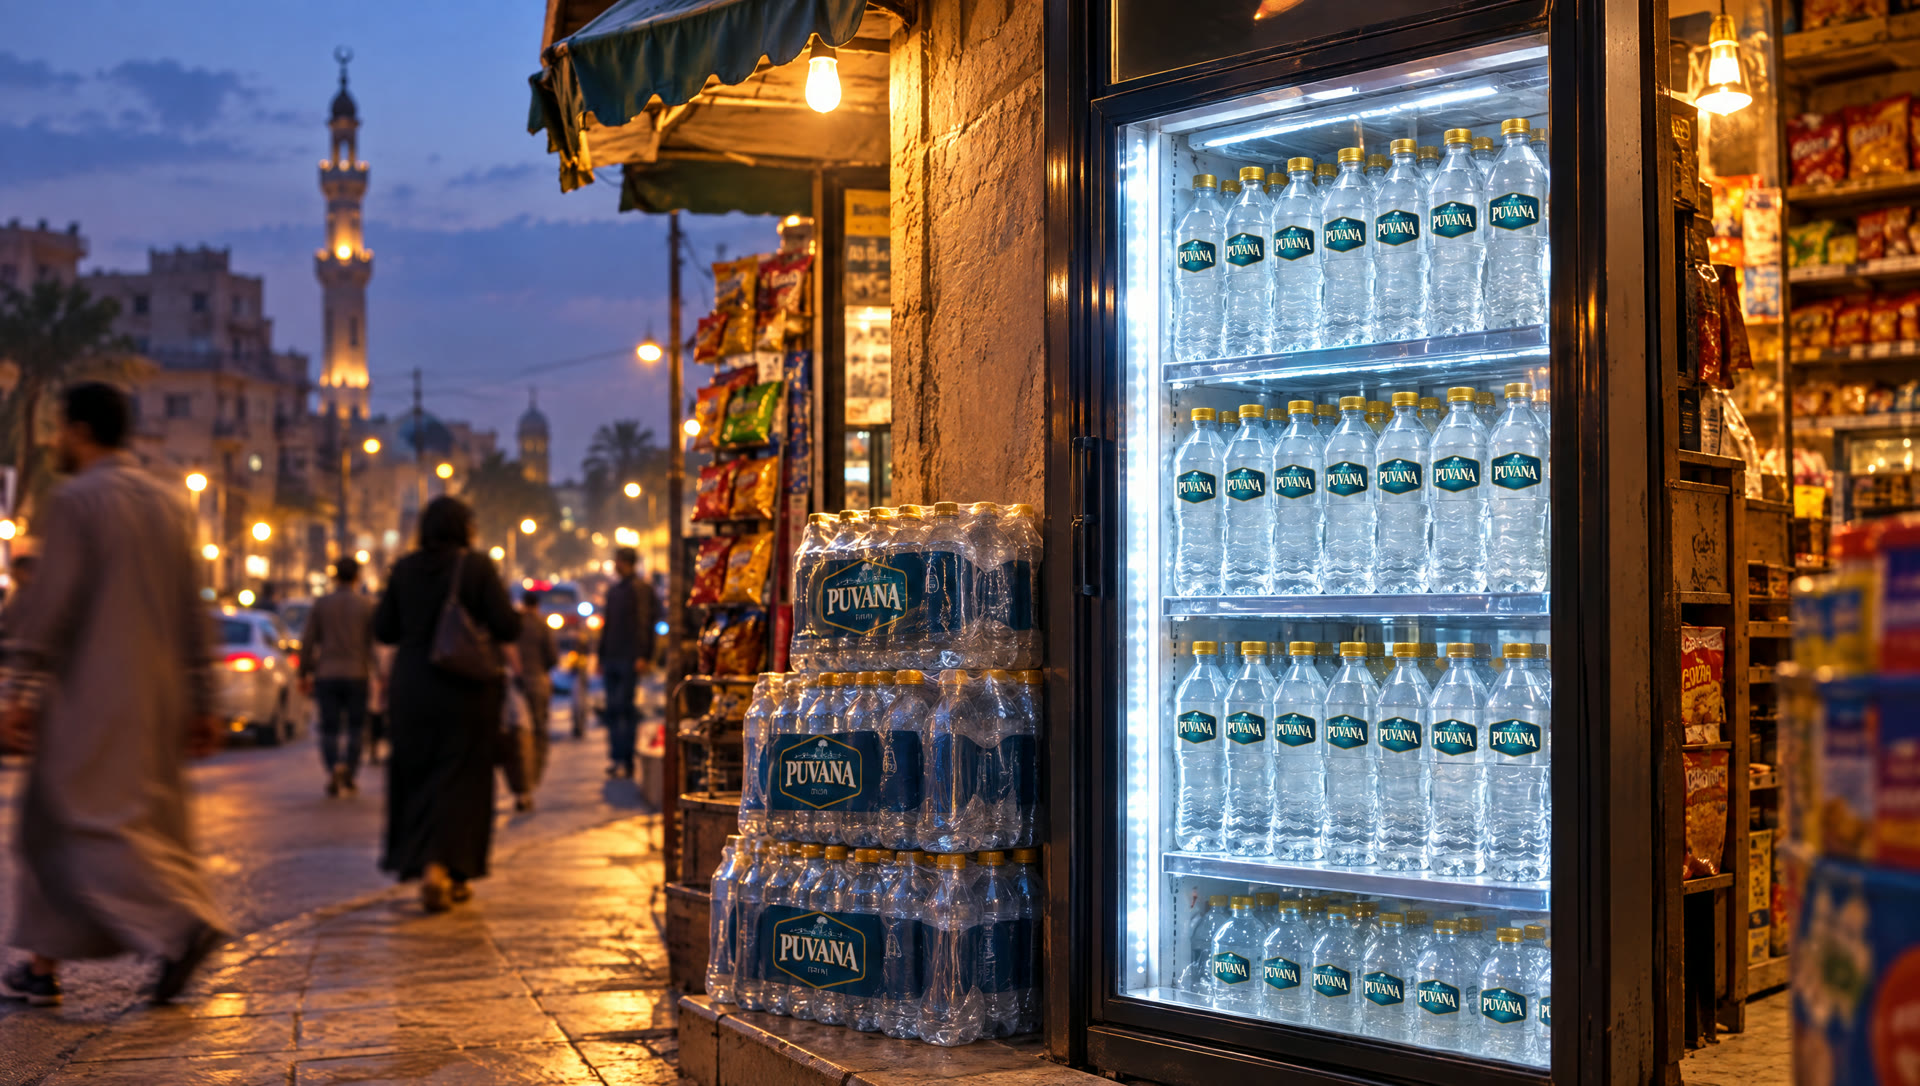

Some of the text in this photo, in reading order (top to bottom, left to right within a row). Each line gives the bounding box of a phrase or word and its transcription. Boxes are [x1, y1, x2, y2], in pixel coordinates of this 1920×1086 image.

[1433, 213, 1473, 230] PUVANA
[1492, 205, 1536, 223] PUVANA
[1326, 228, 1363, 244] PUVANA
[1378, 222, 1417, 237] PUVANA
[1226, 242, 1261, 257] PUVANA
[1275, 236, 1312, 253] PUVANA
[1179, 250, 1213, 265] PUVANA
[1327, 472, 1364, 488] PUVANA
[1379, 470, 1418, 485] PUVANA
[1435, 466, 1476, 483] PUVANA
[1494, 464, 1538, 481] PUVANA
[1179, 480, 1213, 495] PUVANA
[1227, 478, 1262, 494] PUVANA
[1276, 475, 1312, 491] PUVANA
[826, 583, 903, 615] PUVANA
[1179, 720, 1214, 736] PUVANA
[1227, 721, 1262, 737] PUVANA
[1276, 723, 1313, 739] PUVANA
[1327, 724, 1364, 741] PUVANA
[1380, 727, 1419, 745] PUVANA
[1434, 730, 1474, 747] PUVANA
[1492, 730, 1537, 748] PUVANA
[786, 760, 857, 788] PUVANA
[779, 933, 860, 973] PUVANA
[1215, 961, 1247, 978] PUVANA
[1264, 966, 1297, 983] PUVANA
[1313, 973, 1348, 991] PUVANA
[1364, 980, 1401, 999] PUVANA
[1418, 988, 1456, 1008] PUVANA
[1483, 996, 1524, 1016] PUVANA
